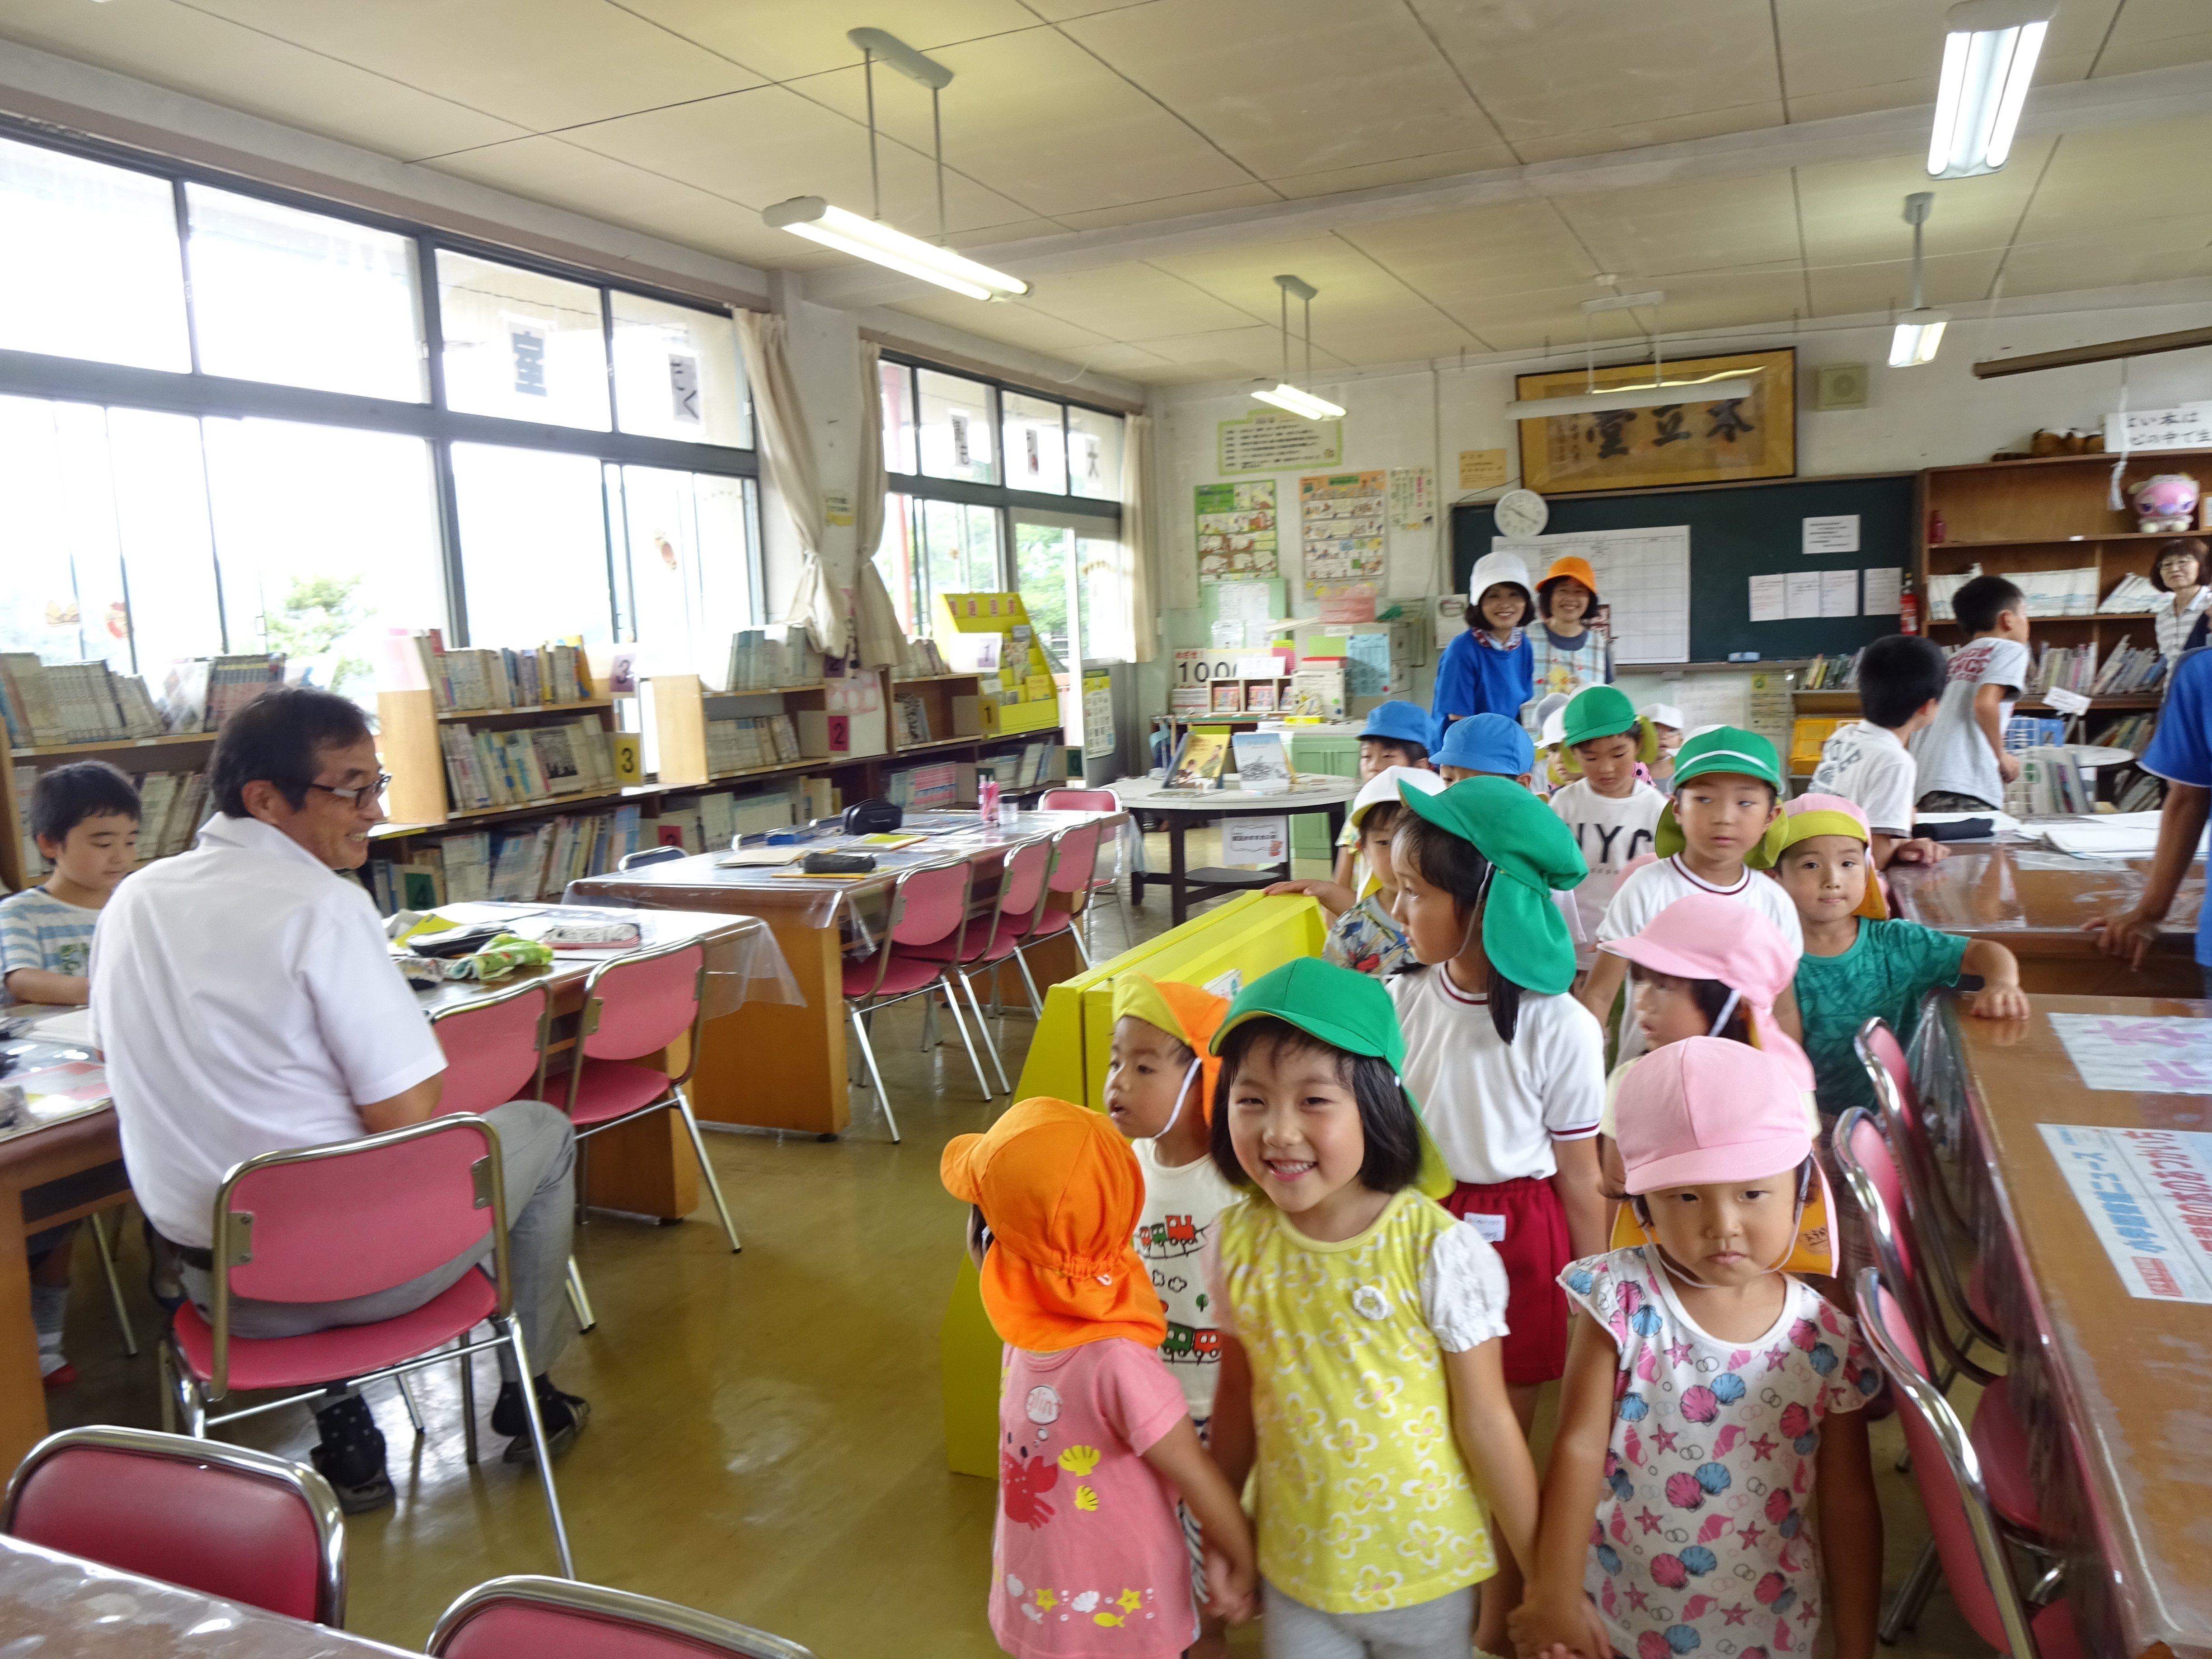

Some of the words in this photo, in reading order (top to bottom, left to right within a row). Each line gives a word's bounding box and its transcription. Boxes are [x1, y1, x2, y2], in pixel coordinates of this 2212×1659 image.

[616, 659, 631, 684] 3
[1177, 661, 1237, 683] 100
[833, 723, 845, 745] 2
[621, 747, 635, 774] 3
